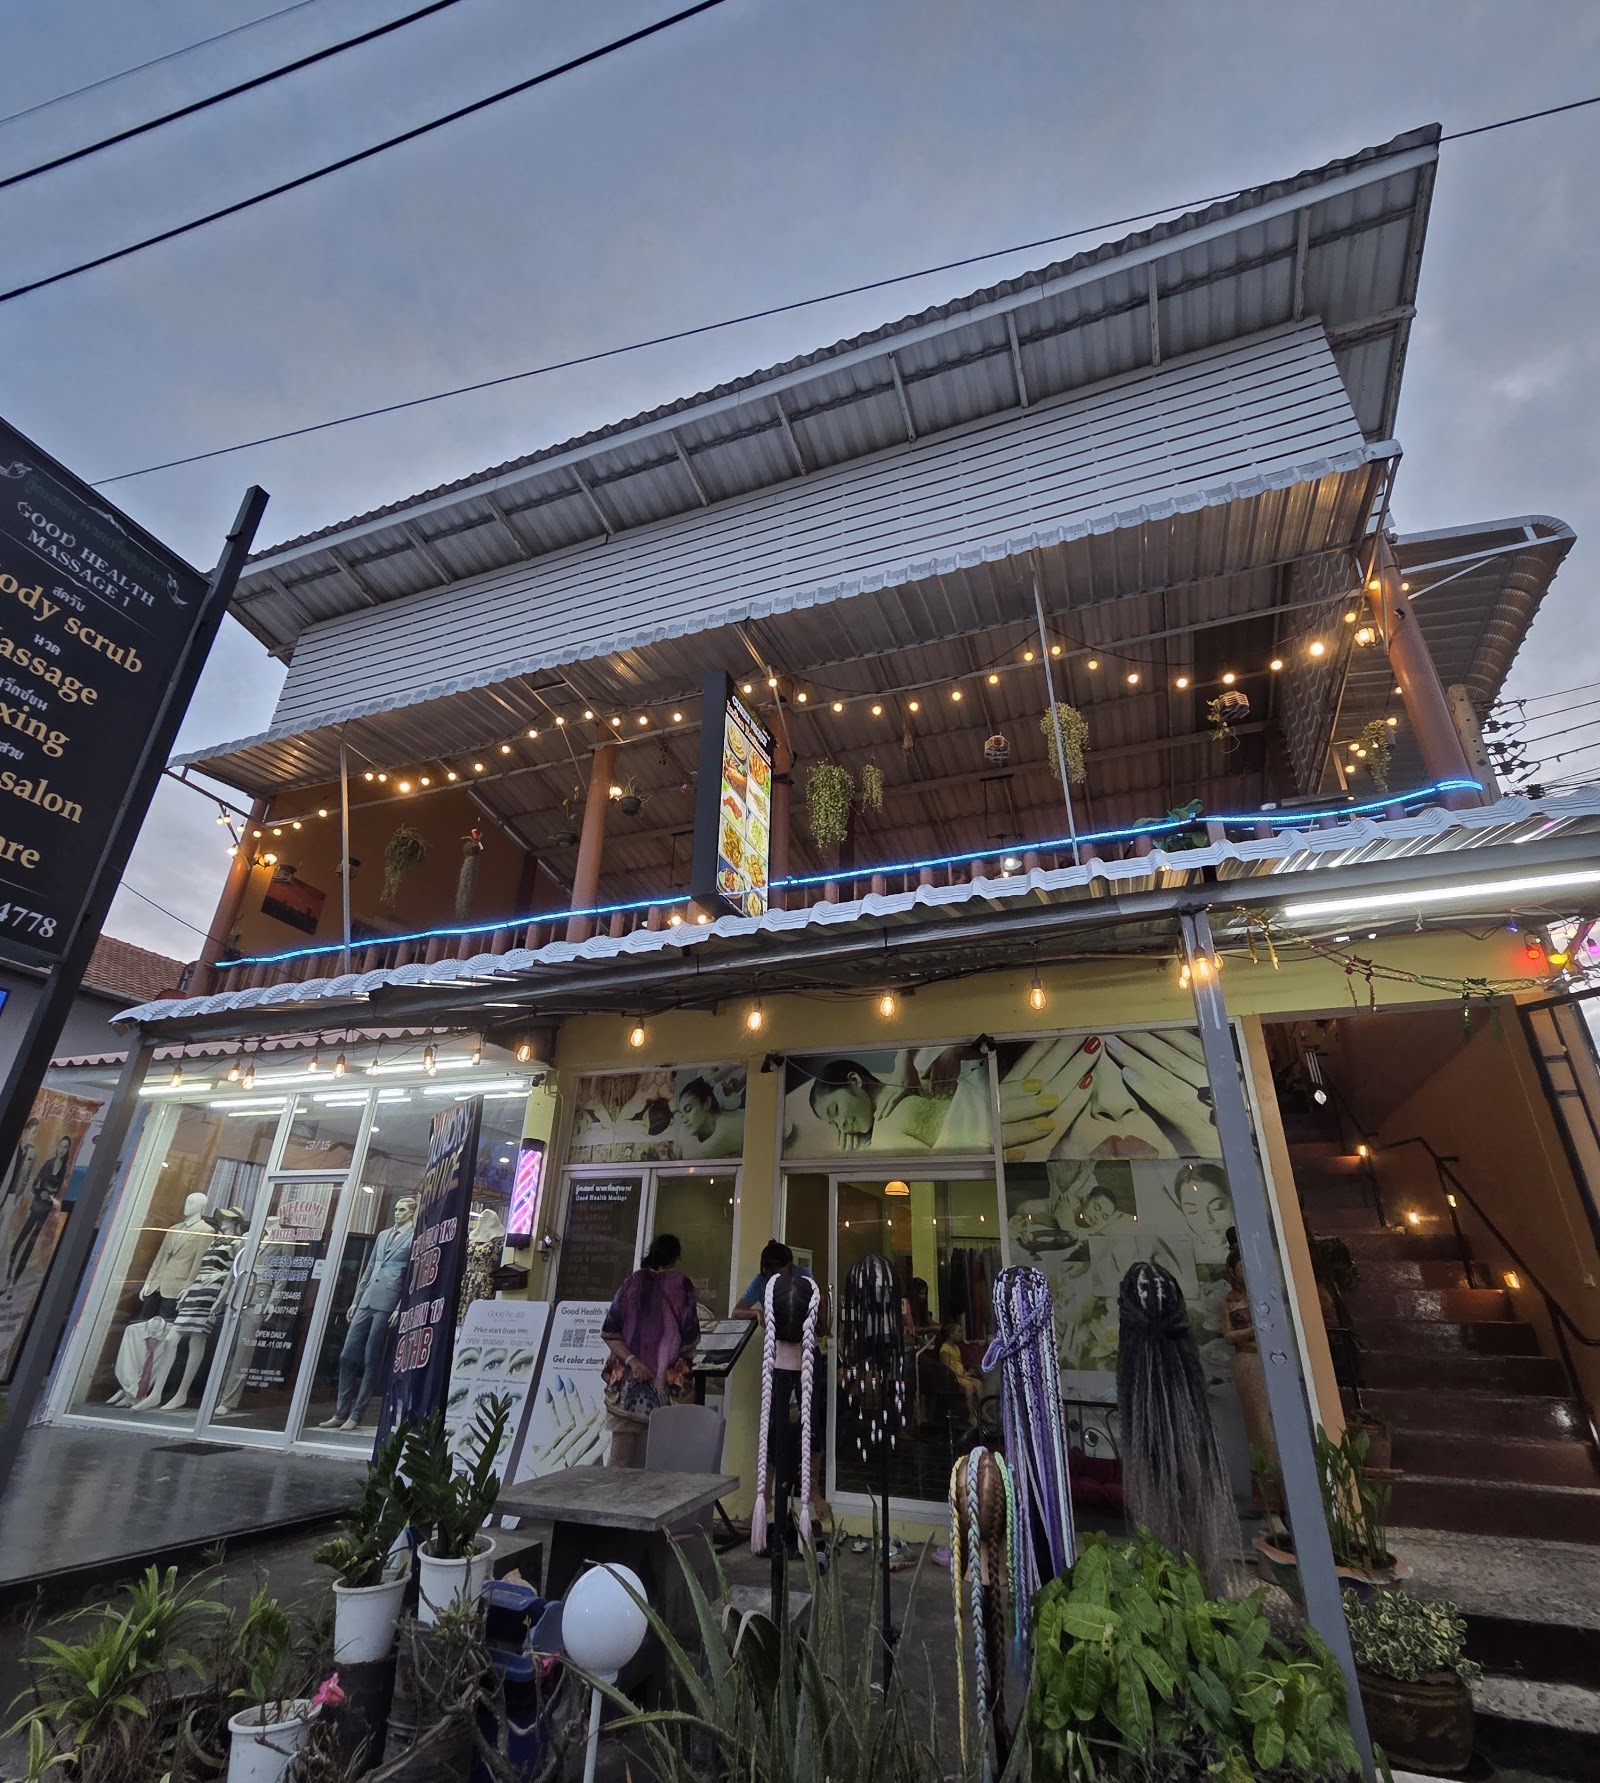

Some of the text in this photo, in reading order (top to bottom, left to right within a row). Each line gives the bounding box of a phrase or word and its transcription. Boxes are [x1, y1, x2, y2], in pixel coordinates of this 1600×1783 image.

[17, 501, 155, 607] GOOD HEALTH
[27, 529, 130, 607] MASSAGE 1
[0, 564, 143, 674] ody scrub
[33, 633, 61, 655] นวด
[0, 630, 98, 706] assage
[0, 770, 83, 824] salon
[278, 1200, 325, 1220] WELCOME
[268, 1228, 296, 1241] MASTER
[263, 1256, 287, 1267] LADIES
[292, 1256, 315, 1268] GENTS
[261, 1270, 309, 1282] CUSTOM MADE
[561, 1307, 580, 1316] Good
[580, 1307, 603, 1316] Health
[255, 1330, 287, 1339] OPEN DAILY
[473, 1326, 487, 1334] Price
[502, 1327, 516, 1335] from
[552, 1354, 605, 1365] Gel color start
